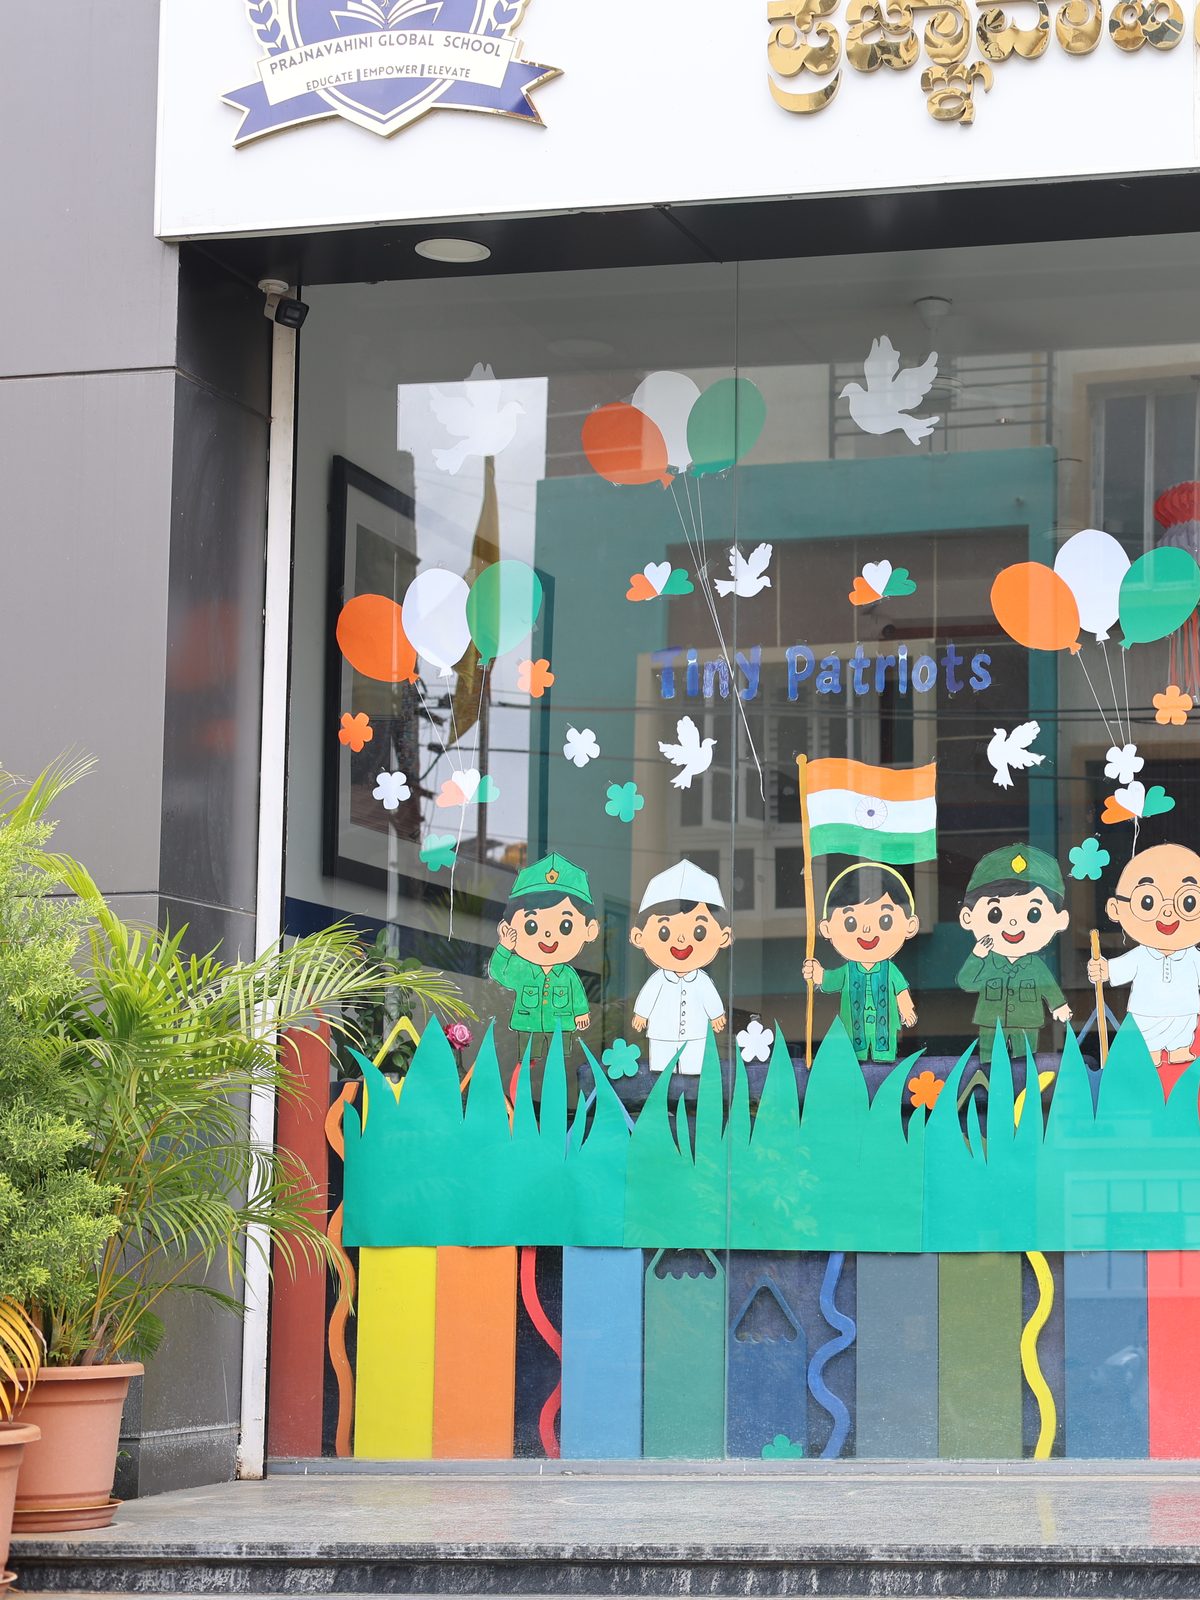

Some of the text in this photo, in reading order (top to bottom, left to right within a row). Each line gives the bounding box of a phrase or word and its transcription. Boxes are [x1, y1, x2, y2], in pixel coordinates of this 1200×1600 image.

[269, 33, 502, 75] PRAJNAVAHINI GLOBAL SCHOOL
[306, 64, 471, 91] EDUCATE EMPOWER ELEVATE
[651, 643, 992, 701] Tiny Patriots
